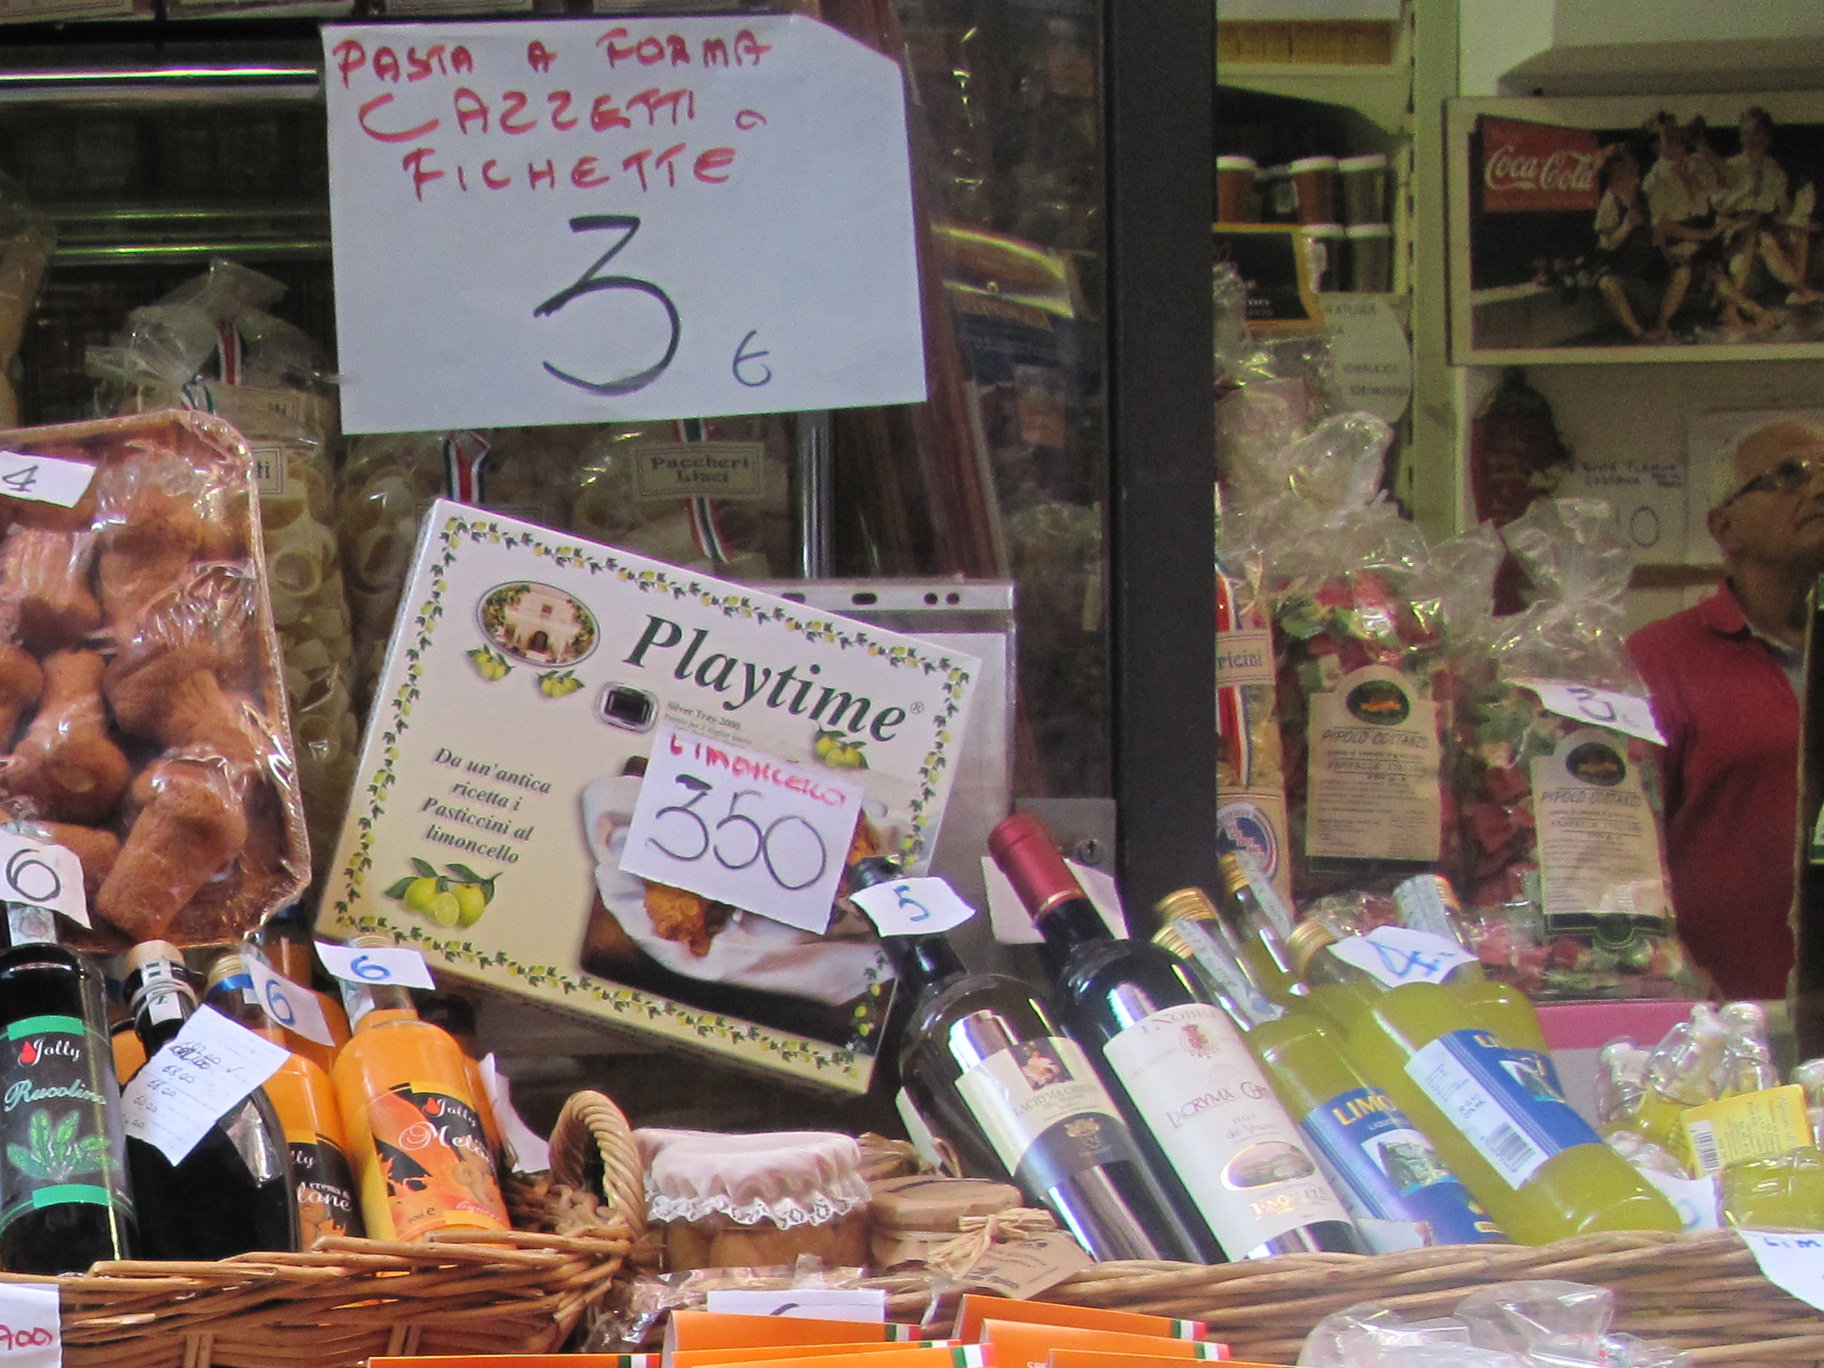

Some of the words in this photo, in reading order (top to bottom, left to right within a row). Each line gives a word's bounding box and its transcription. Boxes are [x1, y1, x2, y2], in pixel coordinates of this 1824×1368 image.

[333, 38, 474, 88] PASTA
[527, 39, 558, 72] A
[596, 26, 773, 69] FORMA
[358, 87, 697, 144] CAZZETTI
[402, 143, 739, 202] FICHETTE
[533, 215, 682, 397] 3
[623, 613, 909, 743] Playtime
[434, 747, 466, 768] Da
[475, 759, 552, 796] un'antica
[450, 778, 508, 810] ricetta
[421, 797, 509, 835] Pasticcini
[515, 824, 534, 844] al
[425, 824, 520, 866] limoncello
[19, 1038, 80, 1067] Jolly
